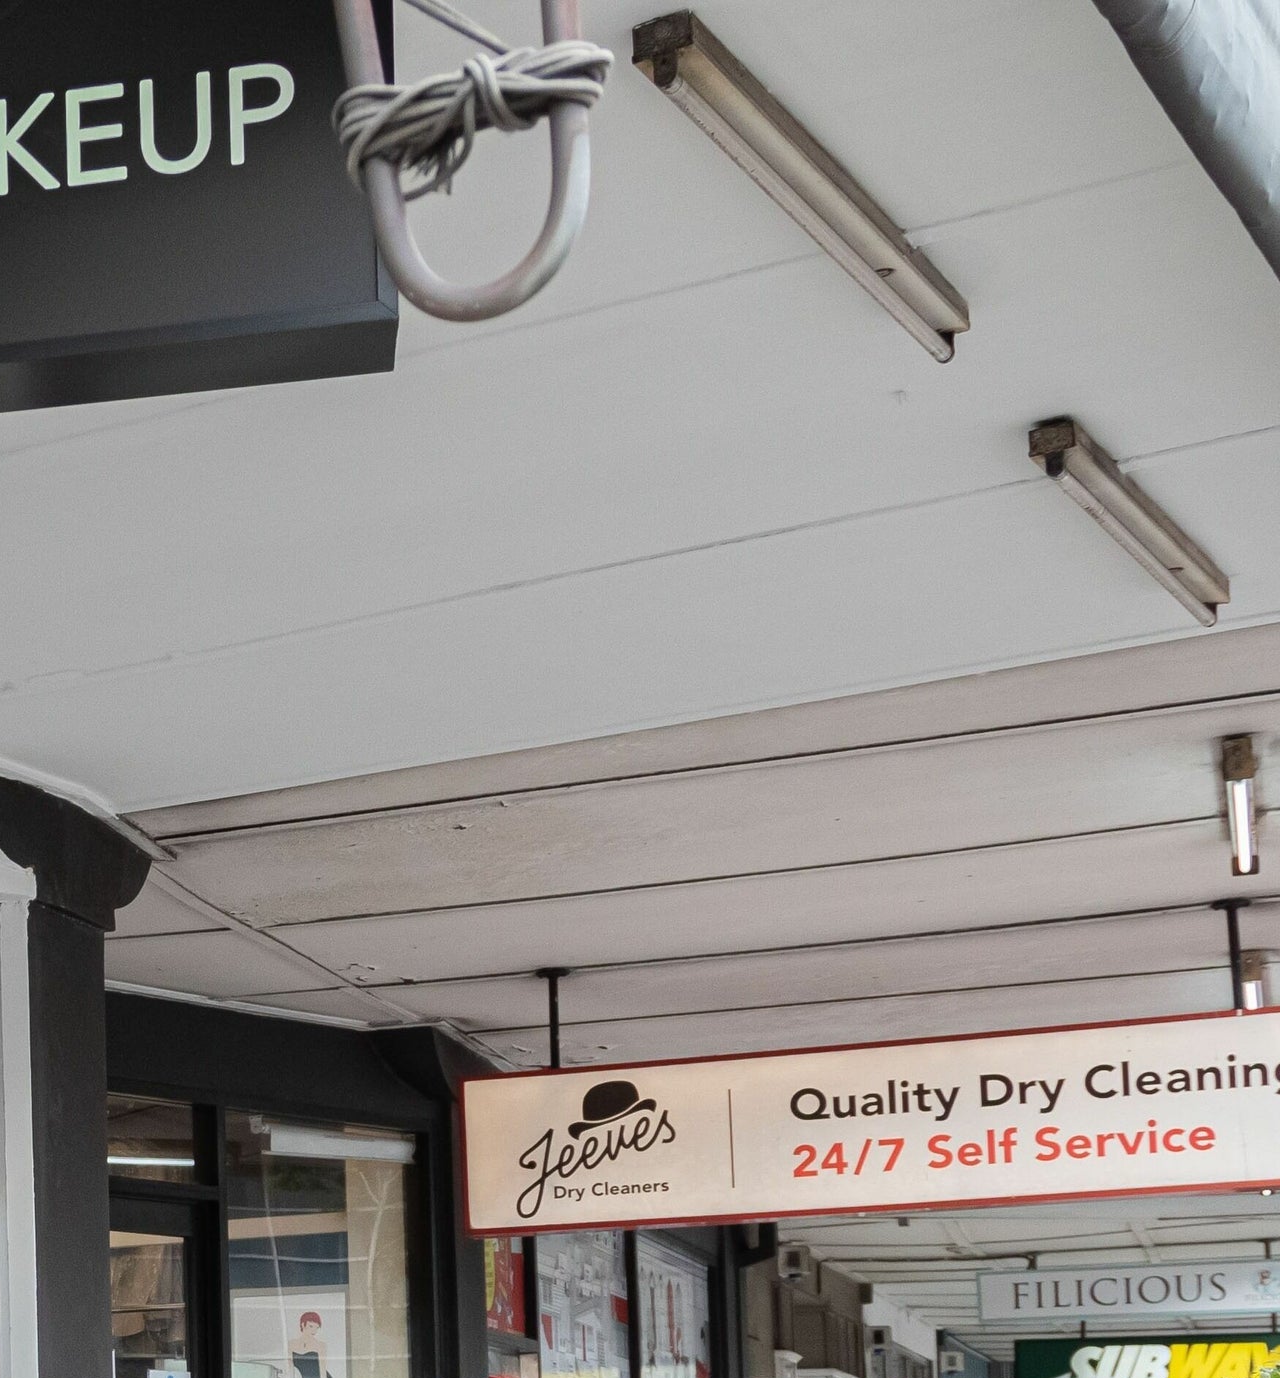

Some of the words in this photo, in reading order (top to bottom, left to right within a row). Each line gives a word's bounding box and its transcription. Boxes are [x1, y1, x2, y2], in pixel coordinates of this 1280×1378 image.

[789, 1078, 960, 1122] Quality
[978, 1073, 1065, 1114] Dry
[516, 1108, 677, 1219] Jeeves
[791, 1136, 906, 1179] 24/7
[927, 1125, 1017, 1170] Self
[1034, 1118, 1217, 1163] Service
[553, 1182, 585, 1202] Dry
[590, 1177, 670, 1197] Cleaners
[1012, 1272, 1227, 1310] FILICIOUS
